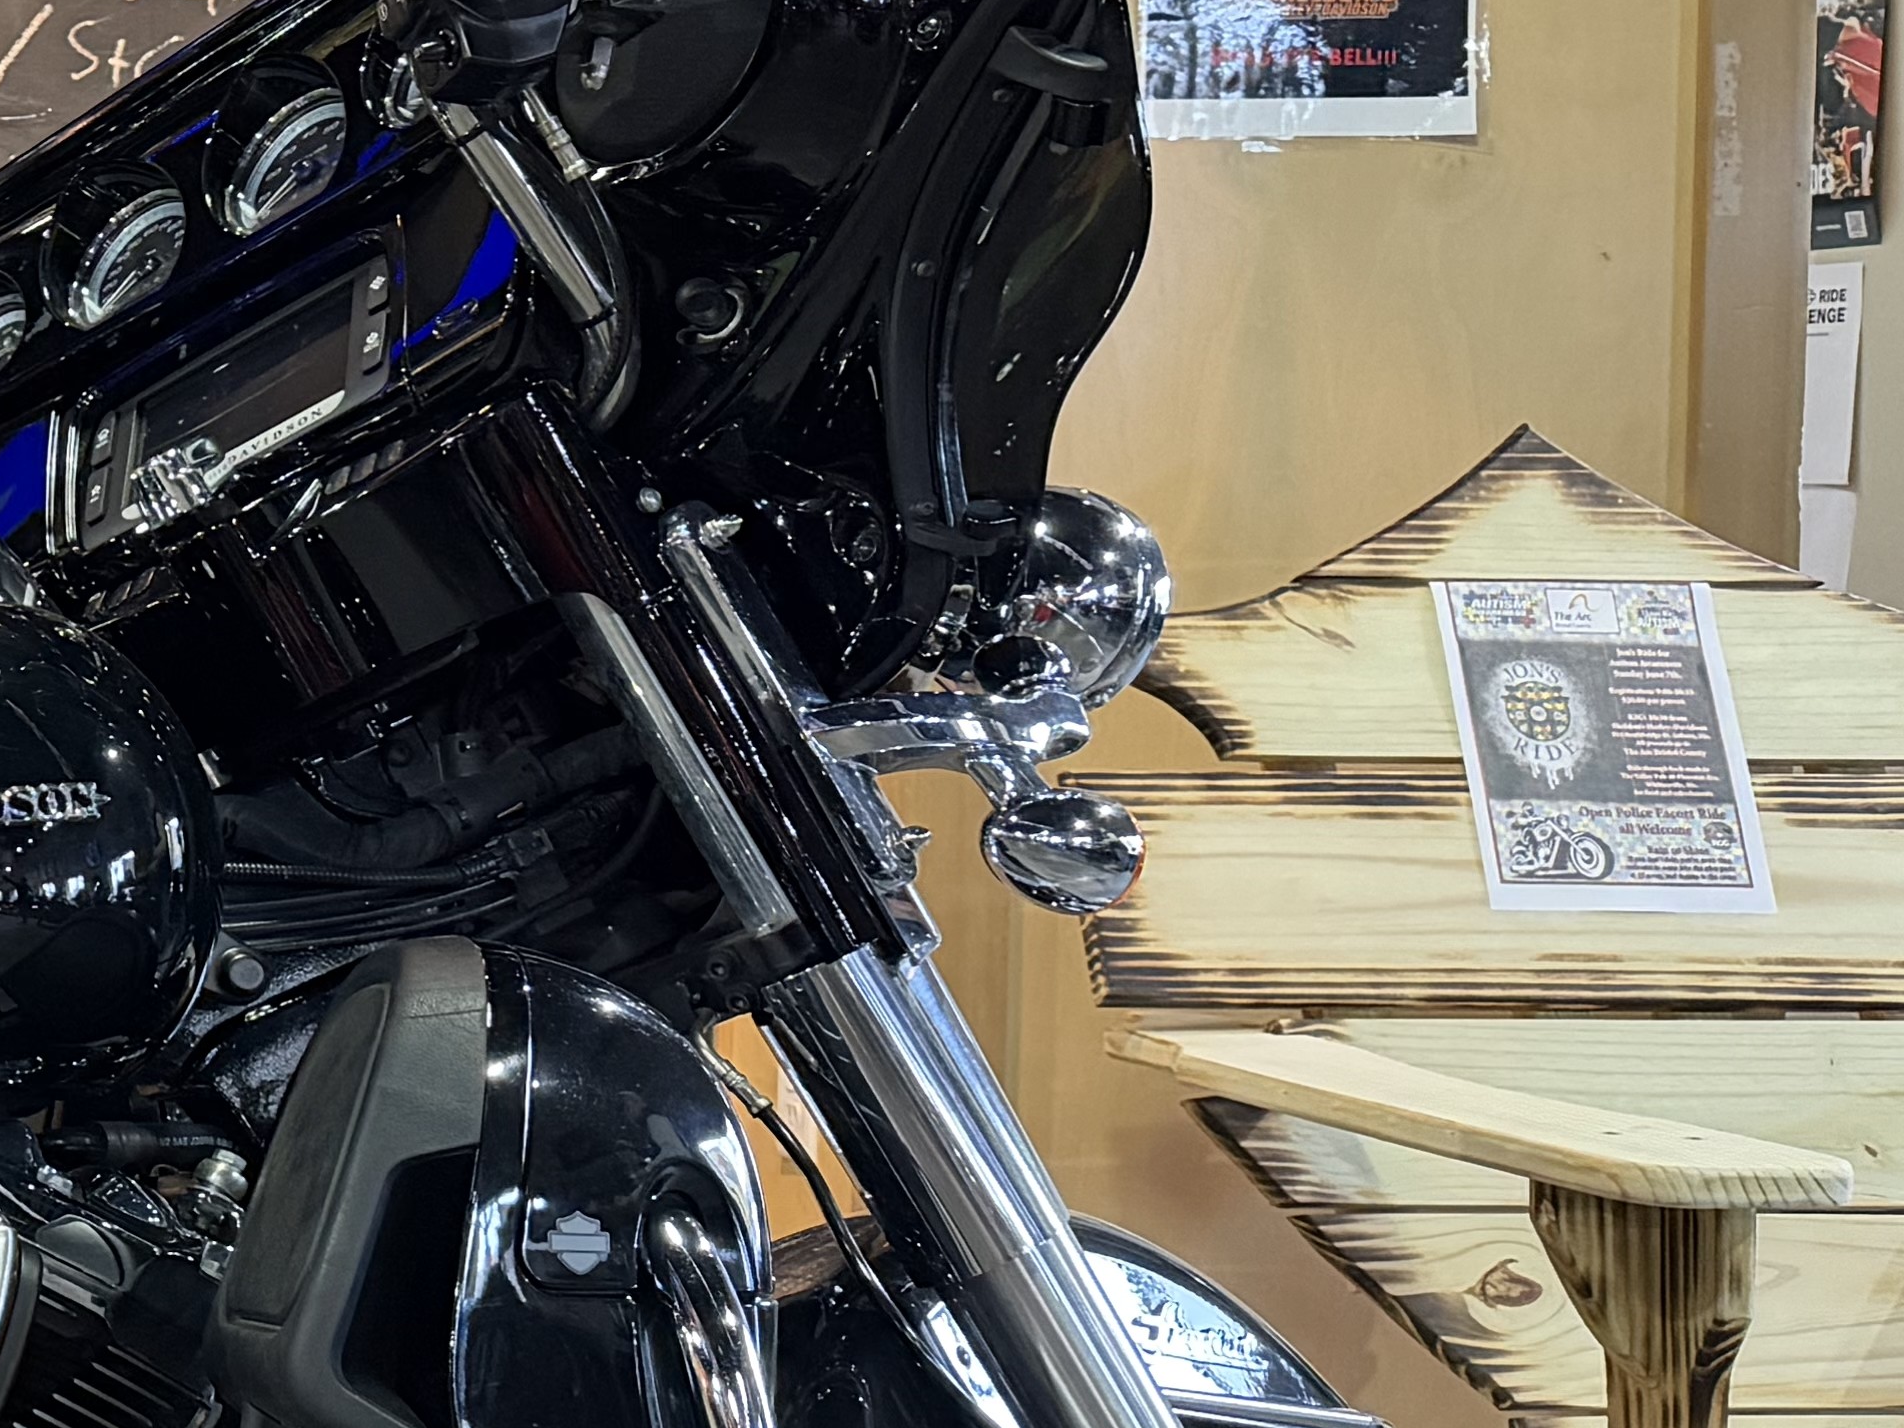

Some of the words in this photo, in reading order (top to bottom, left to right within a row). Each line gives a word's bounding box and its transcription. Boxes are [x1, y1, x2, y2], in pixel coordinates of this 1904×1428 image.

[1819, 289, 1847, 304] RIDE
[1471, 598, 1527, 610] AUTISM
[1555, 611, 1571, 621] The
[1503, 660, 1564, 686] JON'S
[1513, 736, 1578, 763] RIDE
[1578, 805, 1612, 820] Open
[1616, 806, 1653, 819] Police
[1698, 808, 1727, 820] Ride
[1619, 823, 1635, 835] all
[1636, 823, 1693, 836] Welcome
